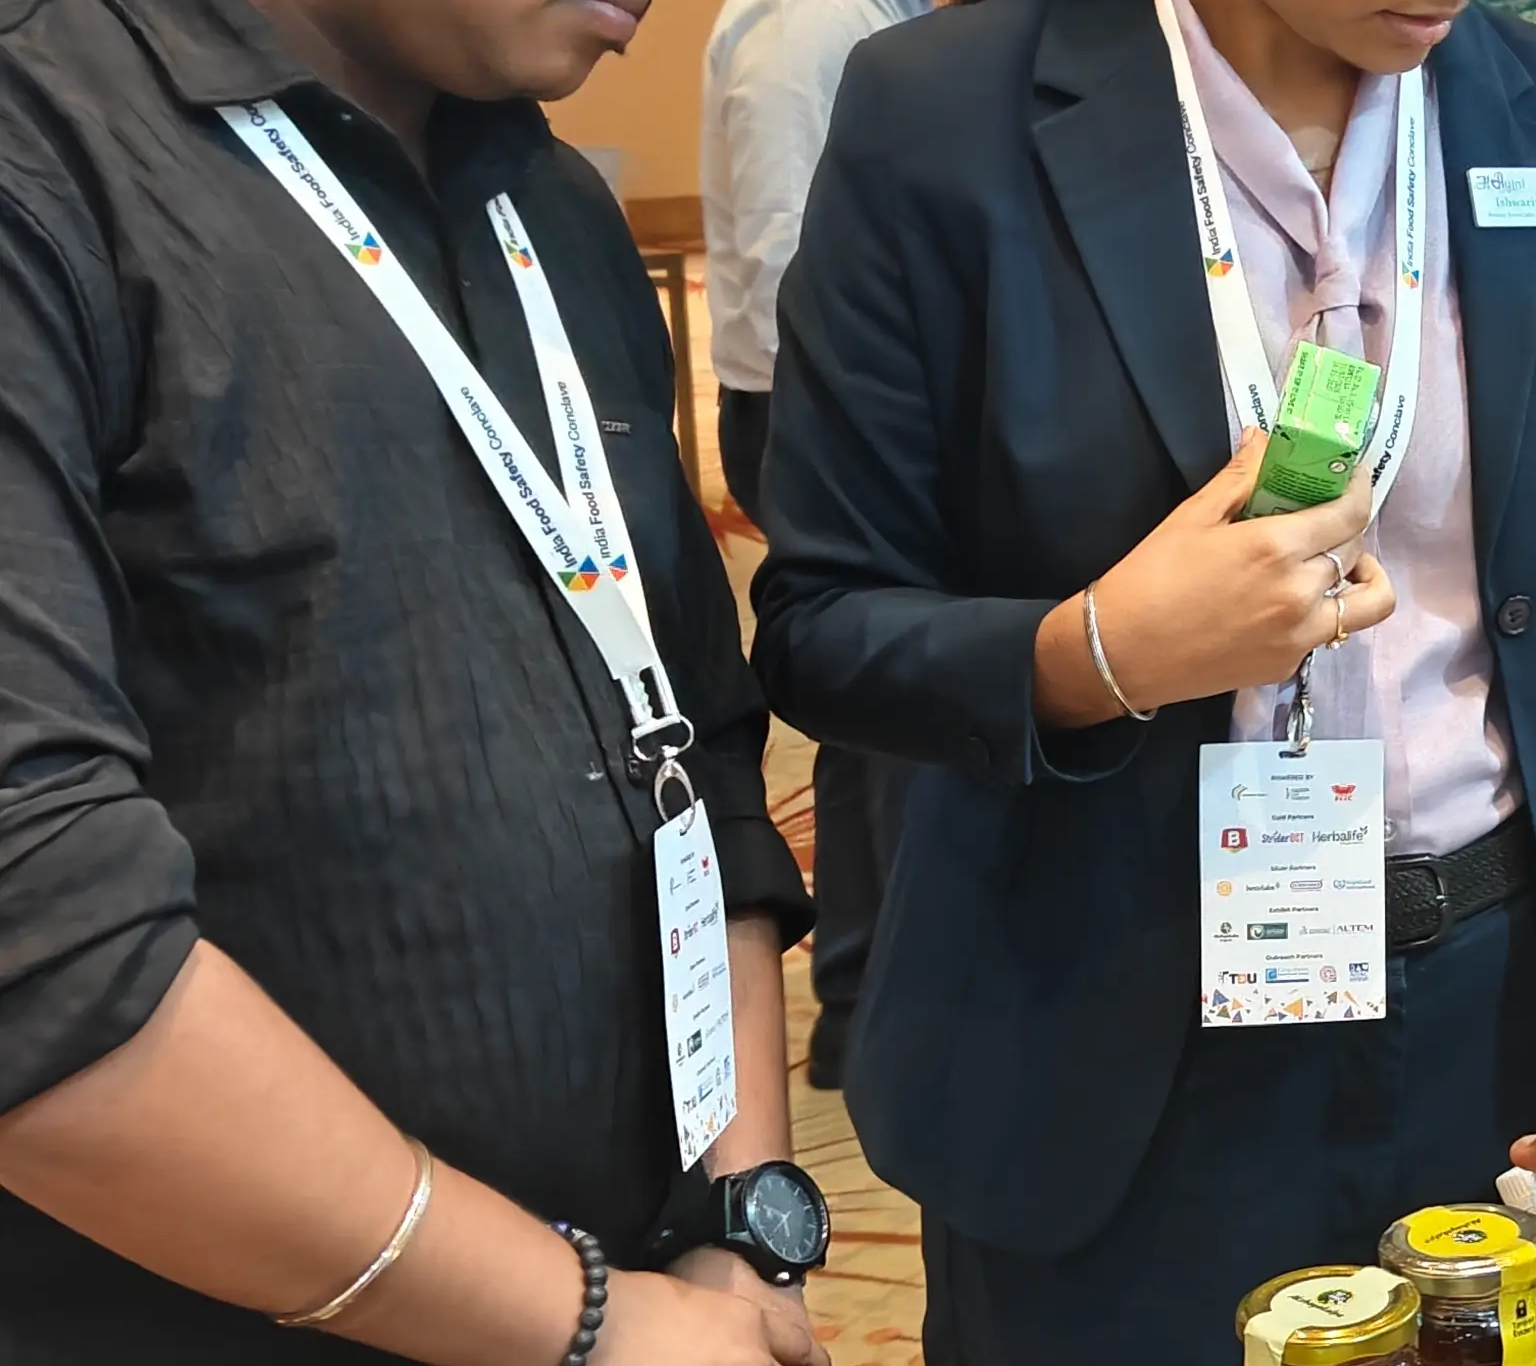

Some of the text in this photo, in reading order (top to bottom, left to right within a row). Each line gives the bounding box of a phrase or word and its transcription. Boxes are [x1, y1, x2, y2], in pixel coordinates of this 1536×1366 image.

[1407, 117, 1415, 167] Conclave
[264, 127, 360, 240] India Food Safety
[1190, 156, 1207, 194] Safety
[1407, 169, 1415, 206] Safety
[1200, 197, 1214, 227] Food
[1209, 229, 1220, 255] India
[1248, 384, 1269, 433] onclave
[1385, 395, 1405, 448] Conclave
[460, 387, 577, 567] India Food Safety Conclave
[558, 382, 611, 558] India Food Safety Conclave
